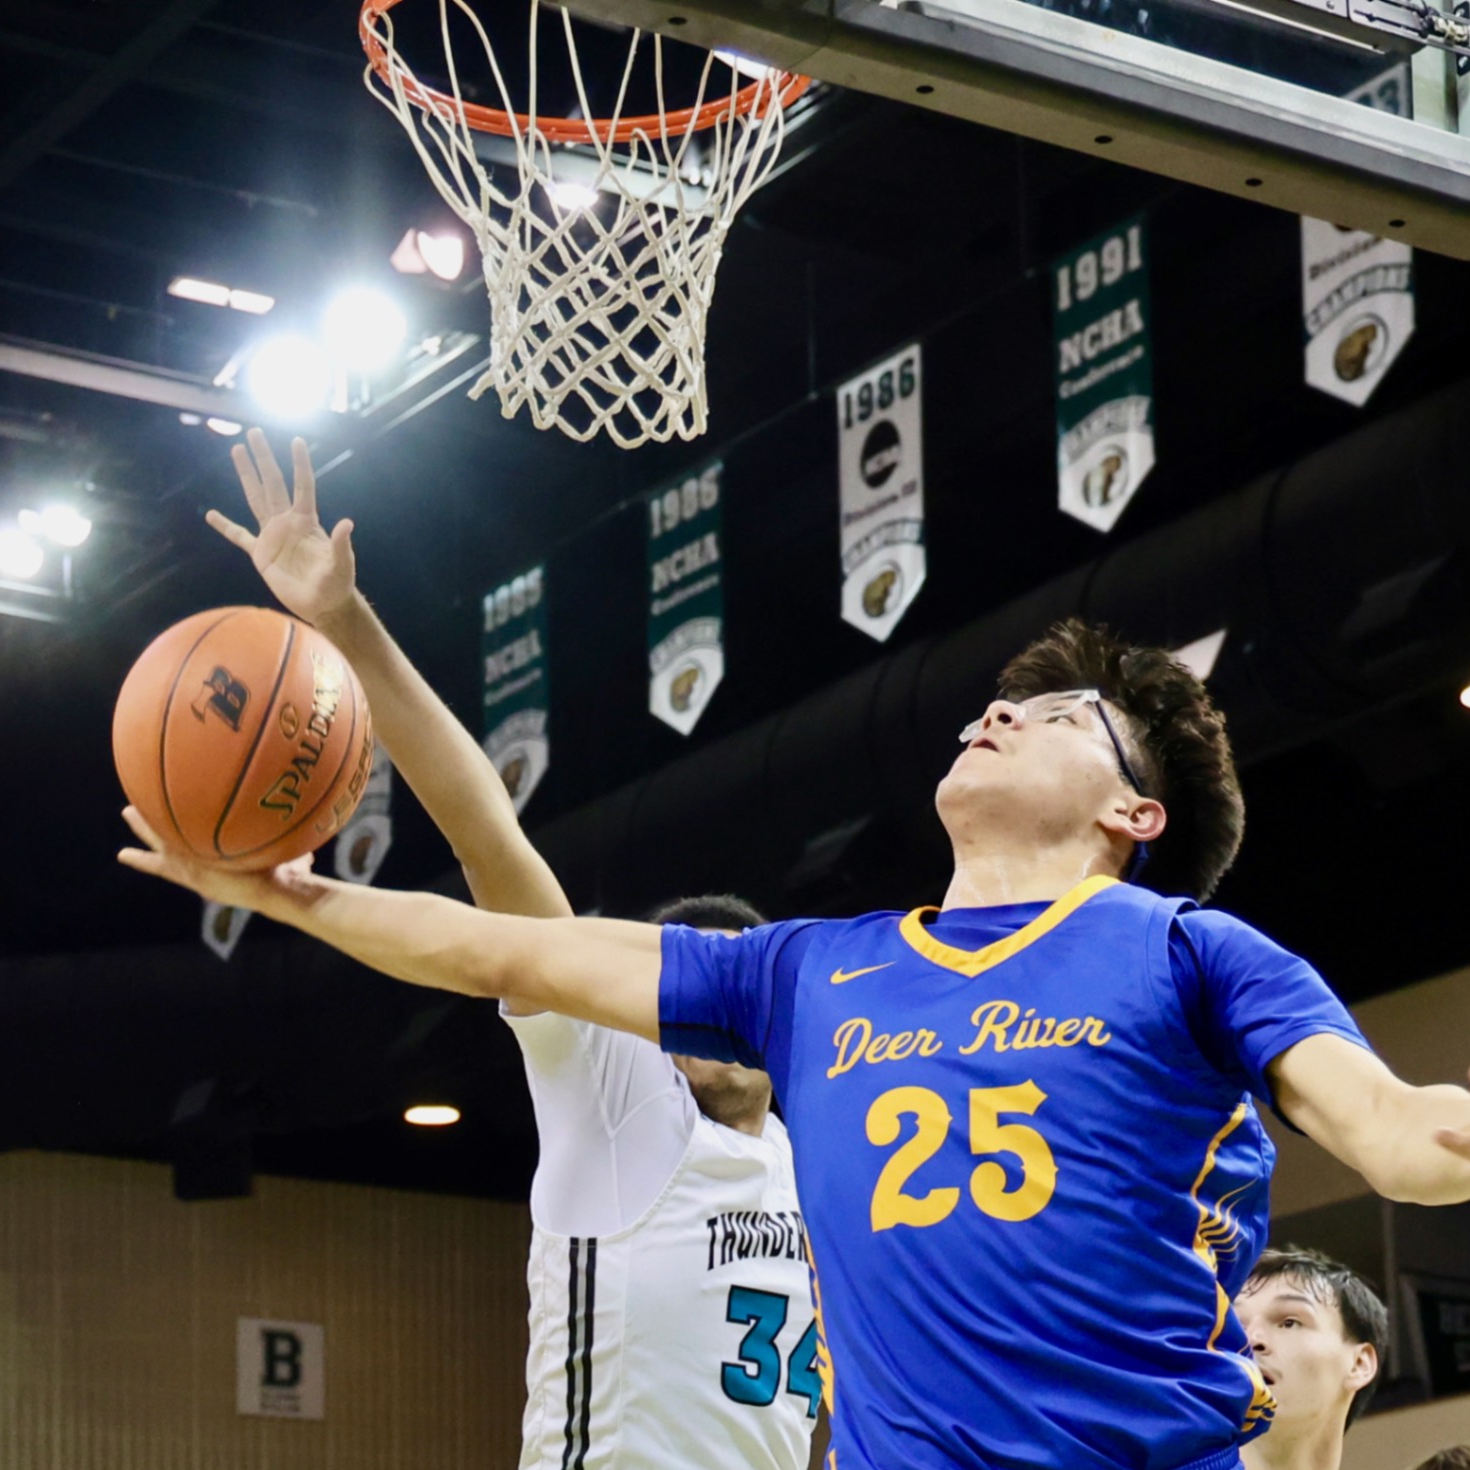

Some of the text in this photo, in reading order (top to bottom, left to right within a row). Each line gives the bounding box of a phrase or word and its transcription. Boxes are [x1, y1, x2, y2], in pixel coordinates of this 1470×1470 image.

[1057, 226, 1142, 312] 1991
[1059, 300, 1144, 374] NCHA
[844, 358, 914, 430] 1986
[259, 648, 344, 821] SPALDIN
[827, 1000, 1111, 1079] Deer River
[865, 1078, 1059, 1233] 25
[262, 1329, 302, 1388] B
[721, 1285, 822, 1419] 34
